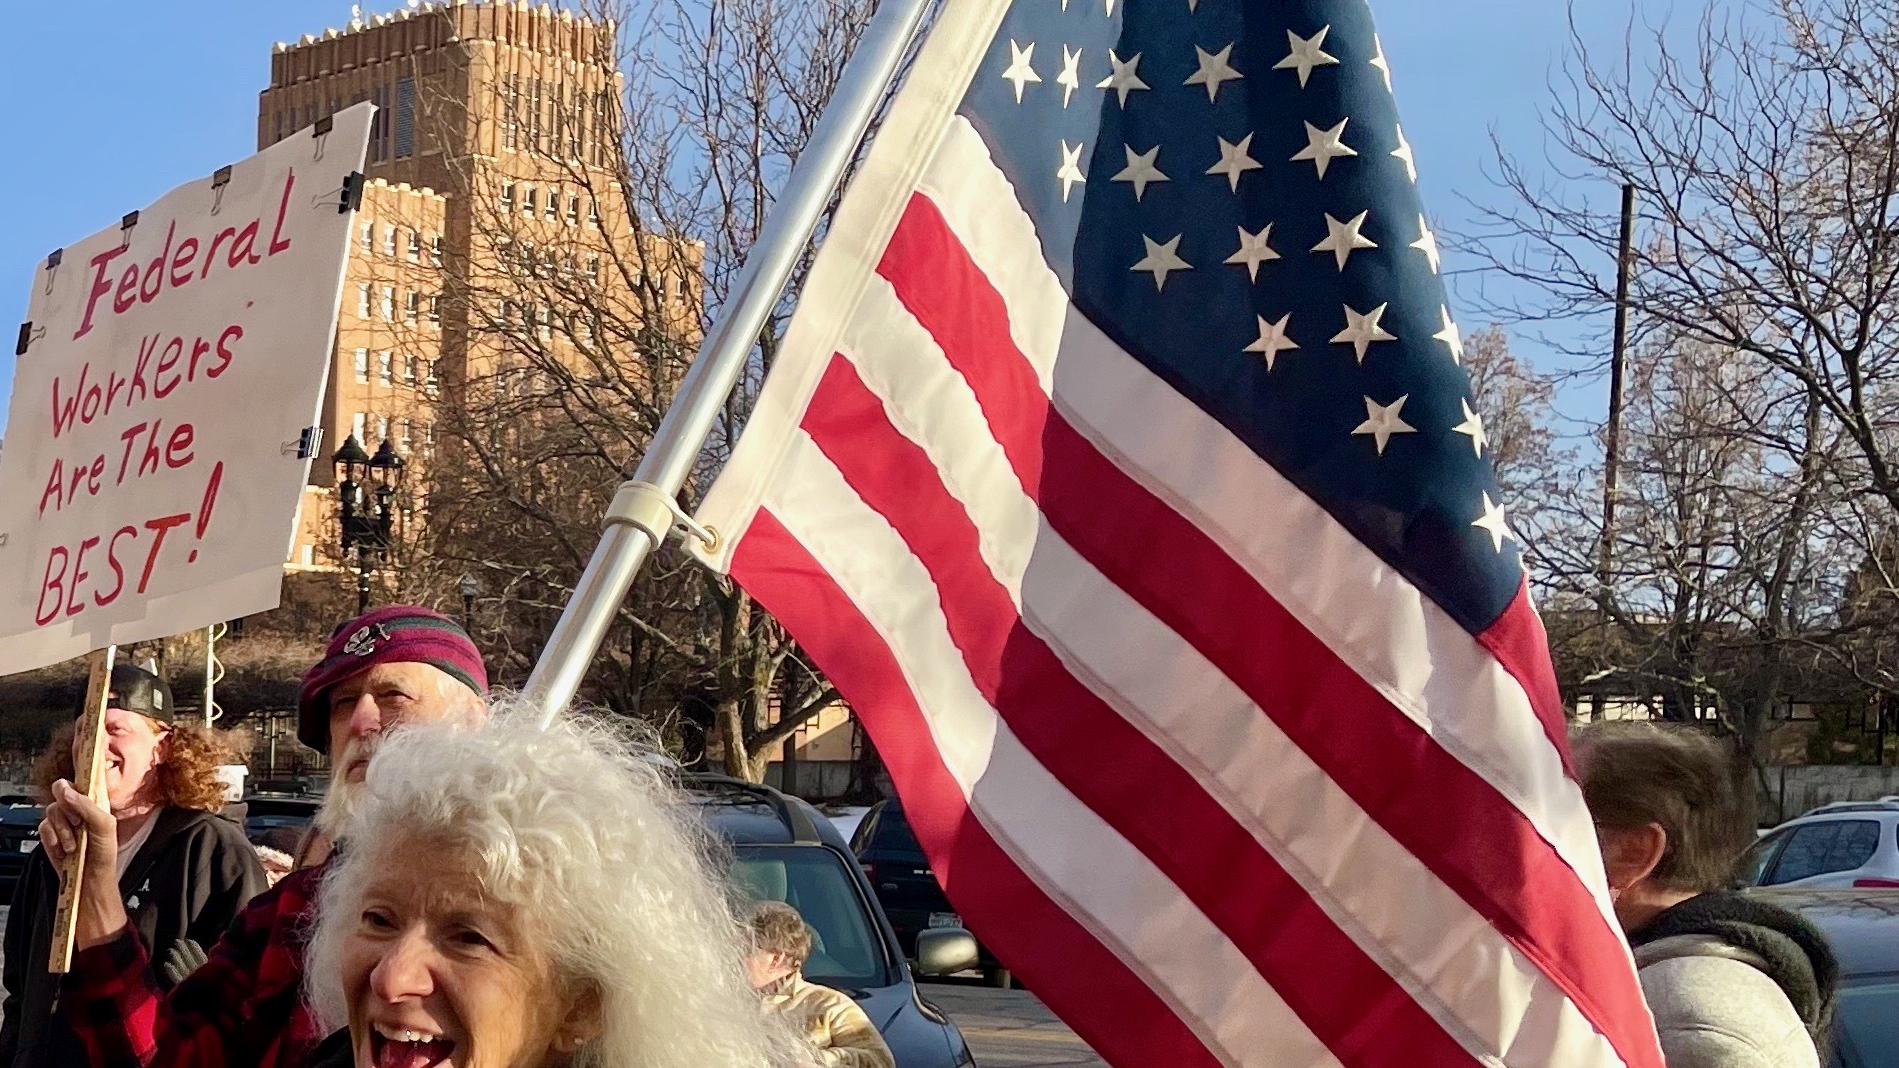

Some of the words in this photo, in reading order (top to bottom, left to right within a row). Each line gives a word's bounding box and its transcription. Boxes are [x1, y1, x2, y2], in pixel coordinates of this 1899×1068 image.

[73, 167, 295, 341] Federal
[35, 461, 224, 627] BEST!
[39, 457, 105, 519] Are
[117, 418, 196, 486] The
